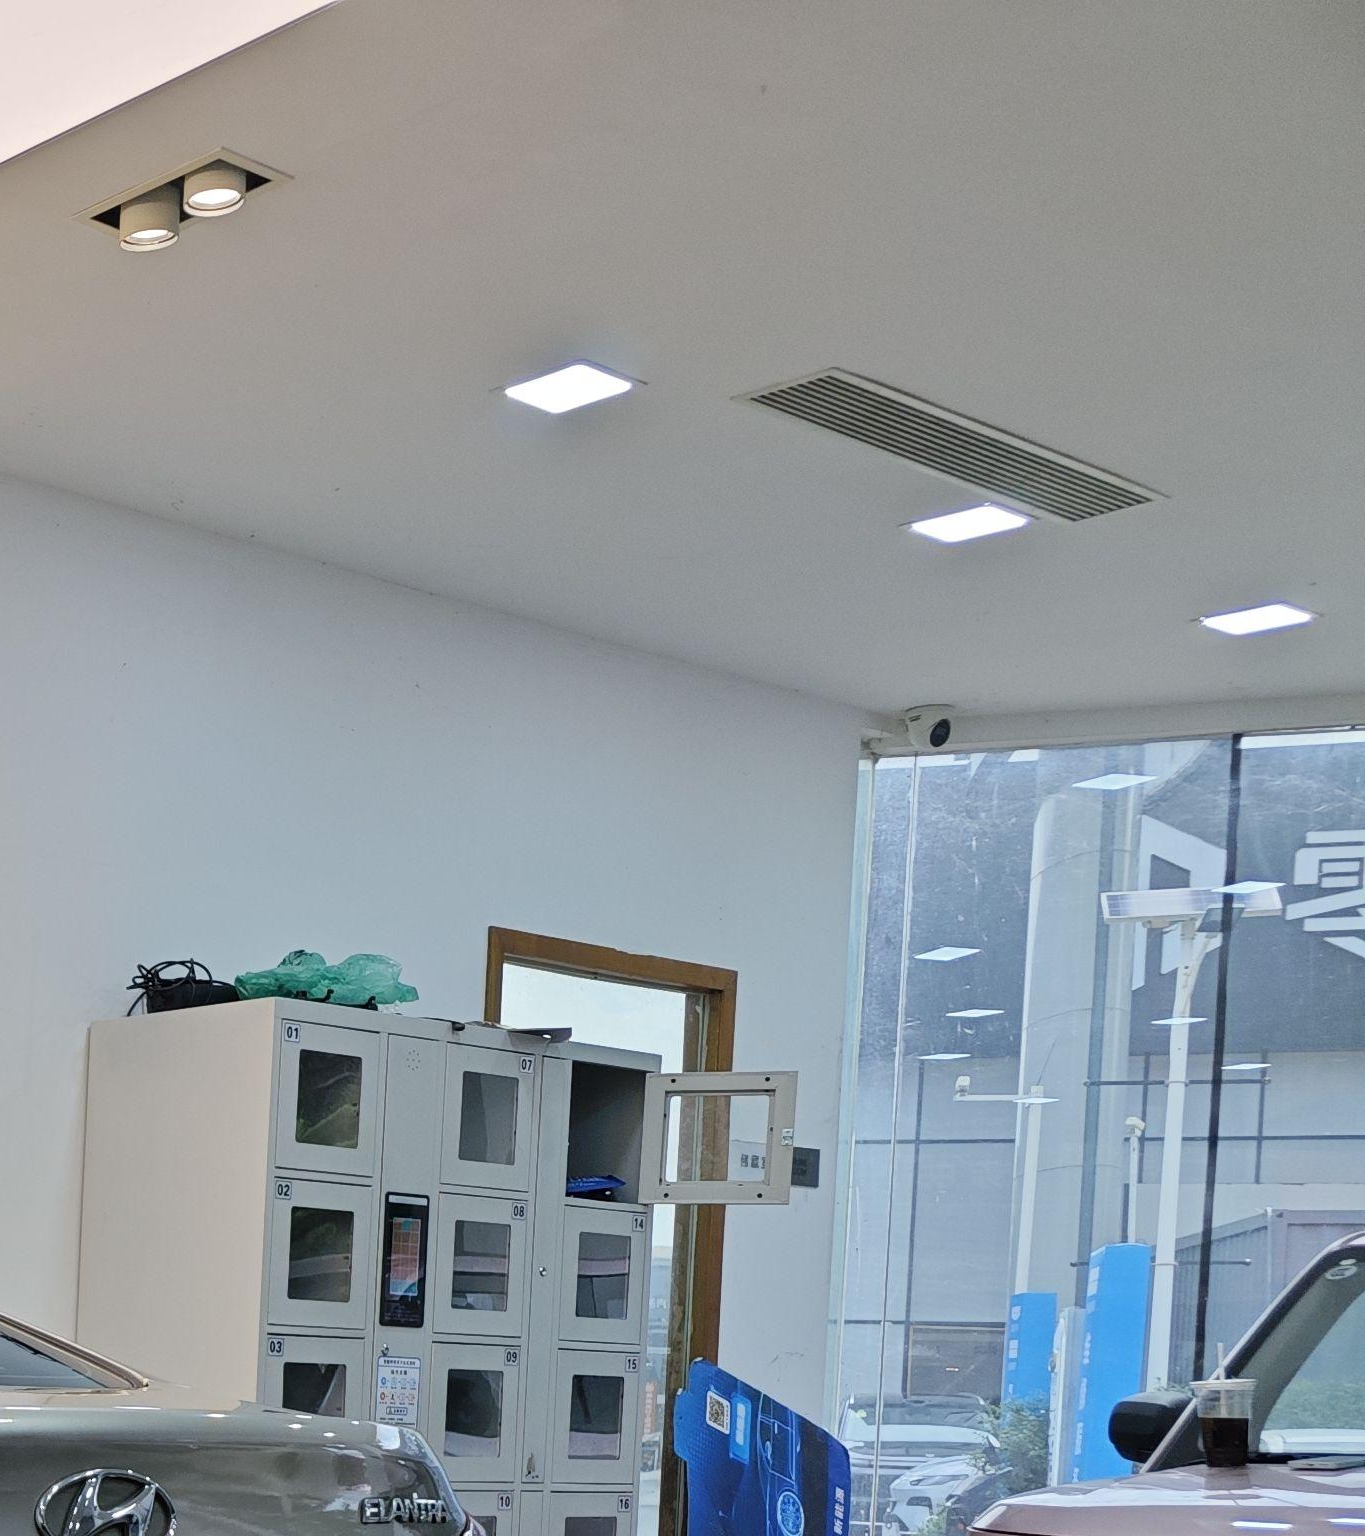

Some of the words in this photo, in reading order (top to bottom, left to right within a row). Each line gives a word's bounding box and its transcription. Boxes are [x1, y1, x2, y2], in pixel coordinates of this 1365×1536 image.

[286, 1026, 299, 1040] 01
[521, 1058, 533, 1071] 07
[277, 1183, 290, 1197] 02
[513, 1205, 525, 1218] 08
[634, 1217, 644, 1230] 14
[269, 1340, 282, 1354] 03
[506, 1351, 518, 1364] 09
[627, 1357, 637, 1370] 15
[499, 1496, 511, 1508] 10
[619, 1498, 630, 1510] 16
[360, 1495, 450, 1525] ELANTRA
